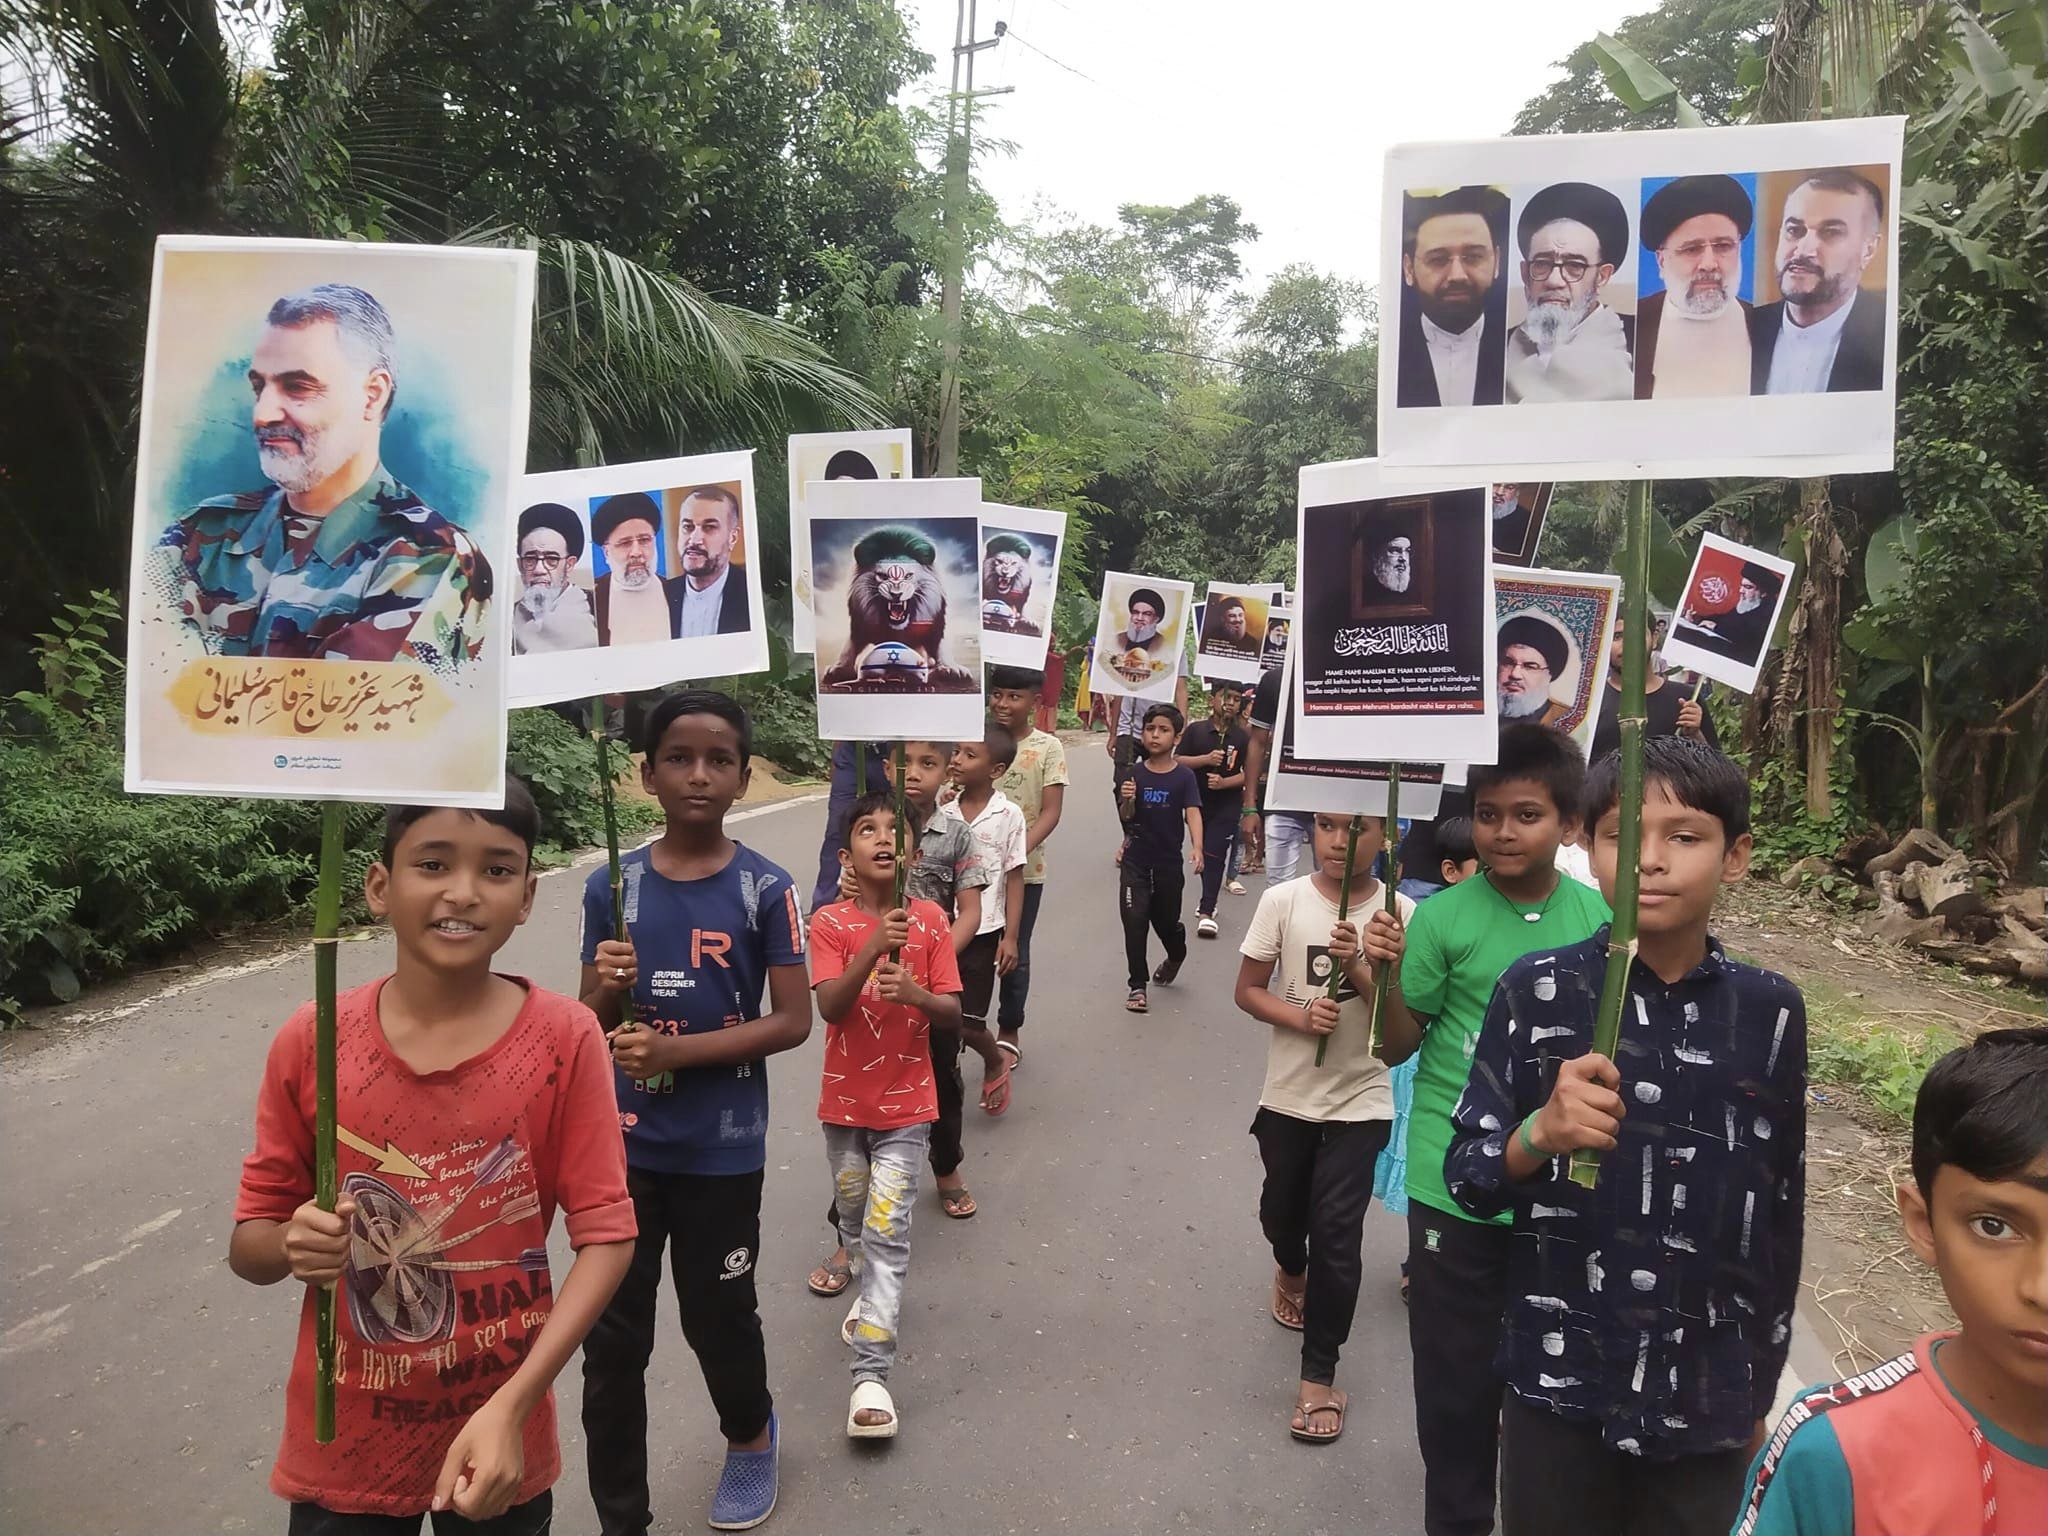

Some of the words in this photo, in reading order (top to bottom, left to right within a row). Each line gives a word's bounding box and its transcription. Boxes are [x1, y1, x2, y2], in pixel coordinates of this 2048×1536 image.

[691, 928, 732, 969] R
[651, 979, 696, 988] DESIGNER
[404, 1177, 428, 1190] The
[479, 1196, 499, 1210] the
[1764, 1402, 1812, 1474] PUMA
